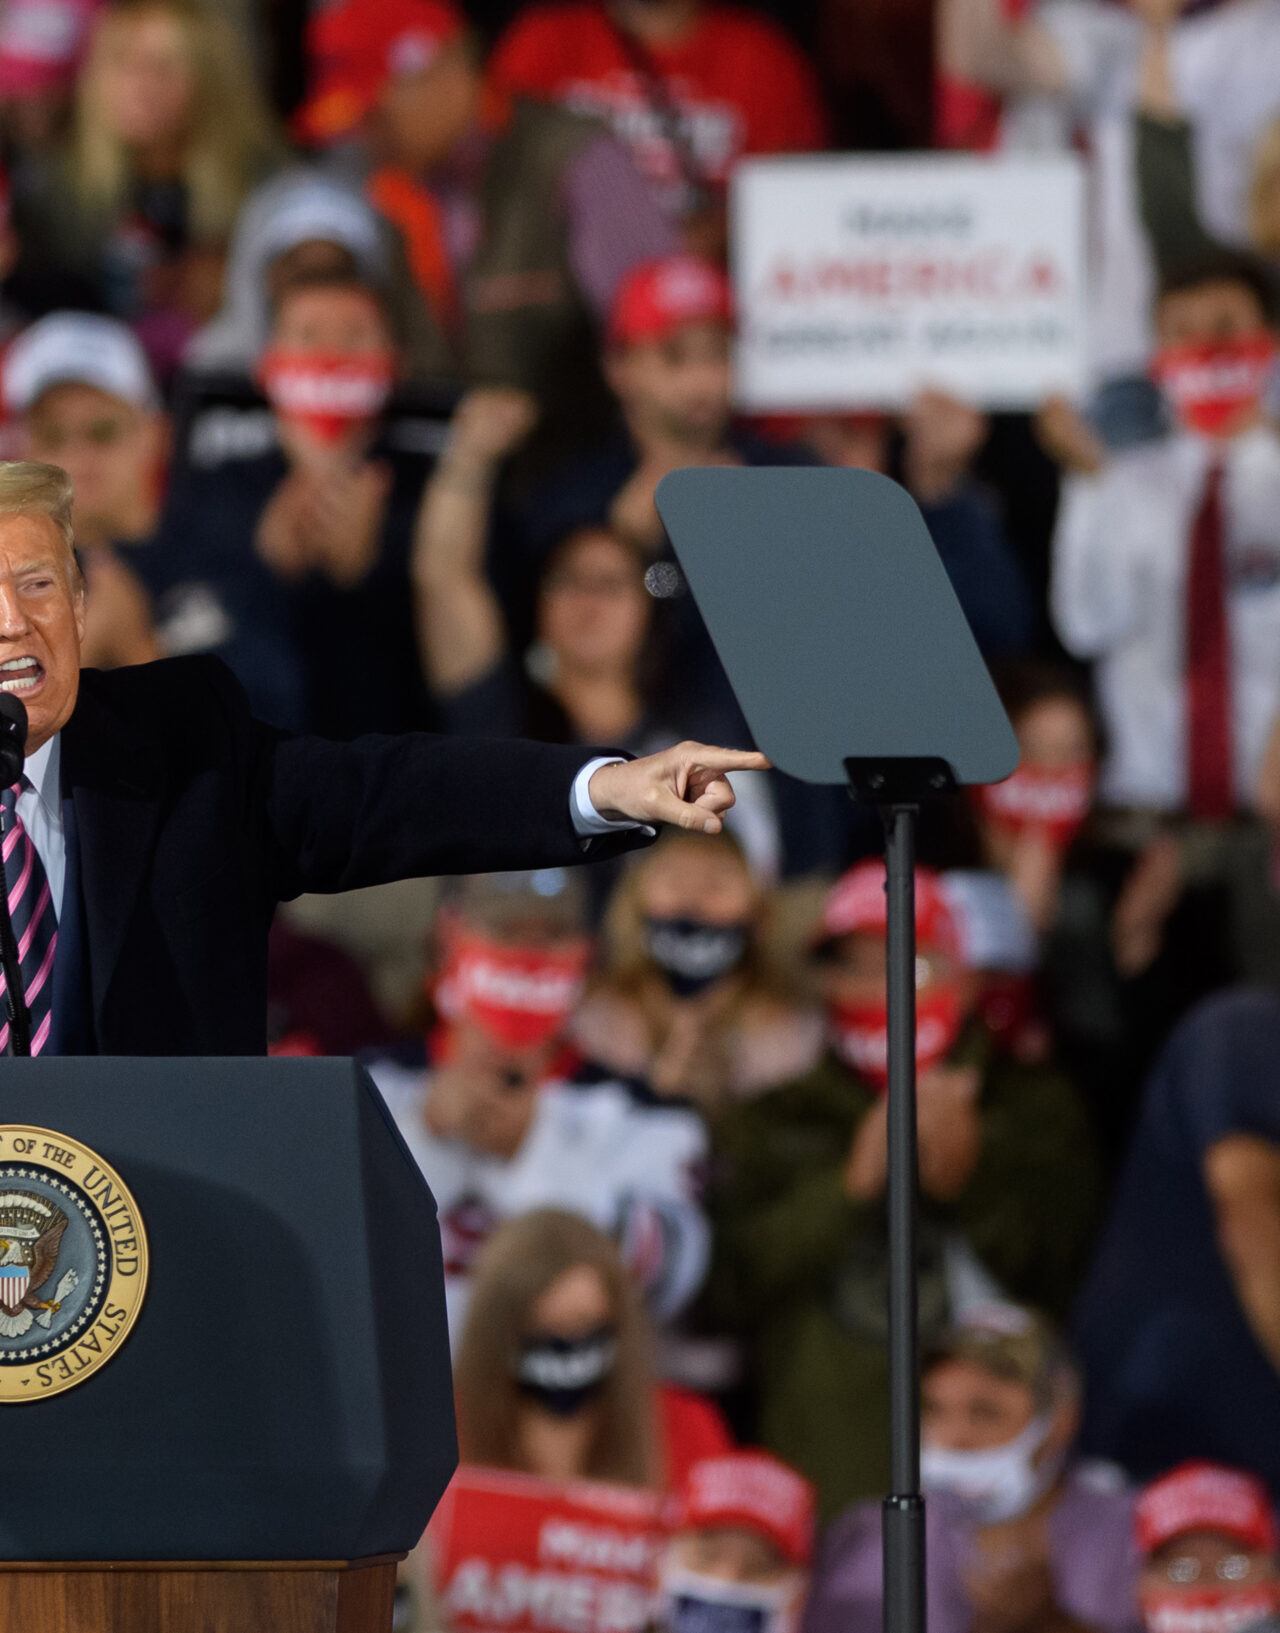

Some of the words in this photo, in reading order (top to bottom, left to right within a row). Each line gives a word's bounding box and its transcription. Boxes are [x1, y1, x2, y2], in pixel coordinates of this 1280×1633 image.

[767, 250, 1066, 304] AMERICA
[13, 1138, 36, 1154] OF
[43, 1142, 76, 1169] THE
[83, 1166, 139, 1277] UNITED
[36, 1302, 127, 1387] STATES
[446, 1557, 654, 1633] AMER
